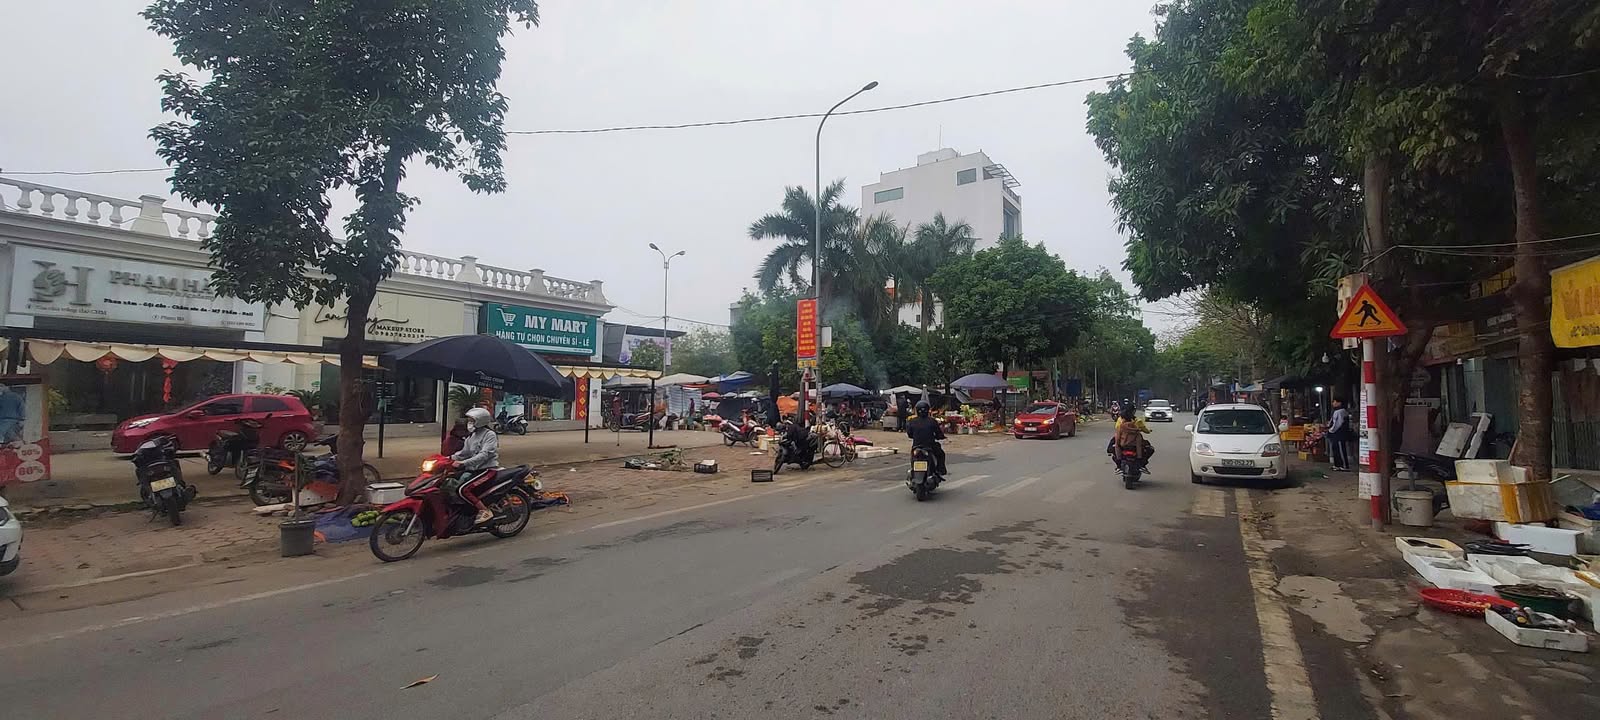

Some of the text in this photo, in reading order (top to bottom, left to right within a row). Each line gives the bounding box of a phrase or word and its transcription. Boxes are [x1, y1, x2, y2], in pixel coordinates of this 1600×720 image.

[524, 314, 588, 334] MY MART
[495, 329, 515, 340] HÀNG
[516, 331, 526, 343] TỰ
[527, 333, 545, 344] CHỌN
[546, 335, 571, 345] CHUYÊN
